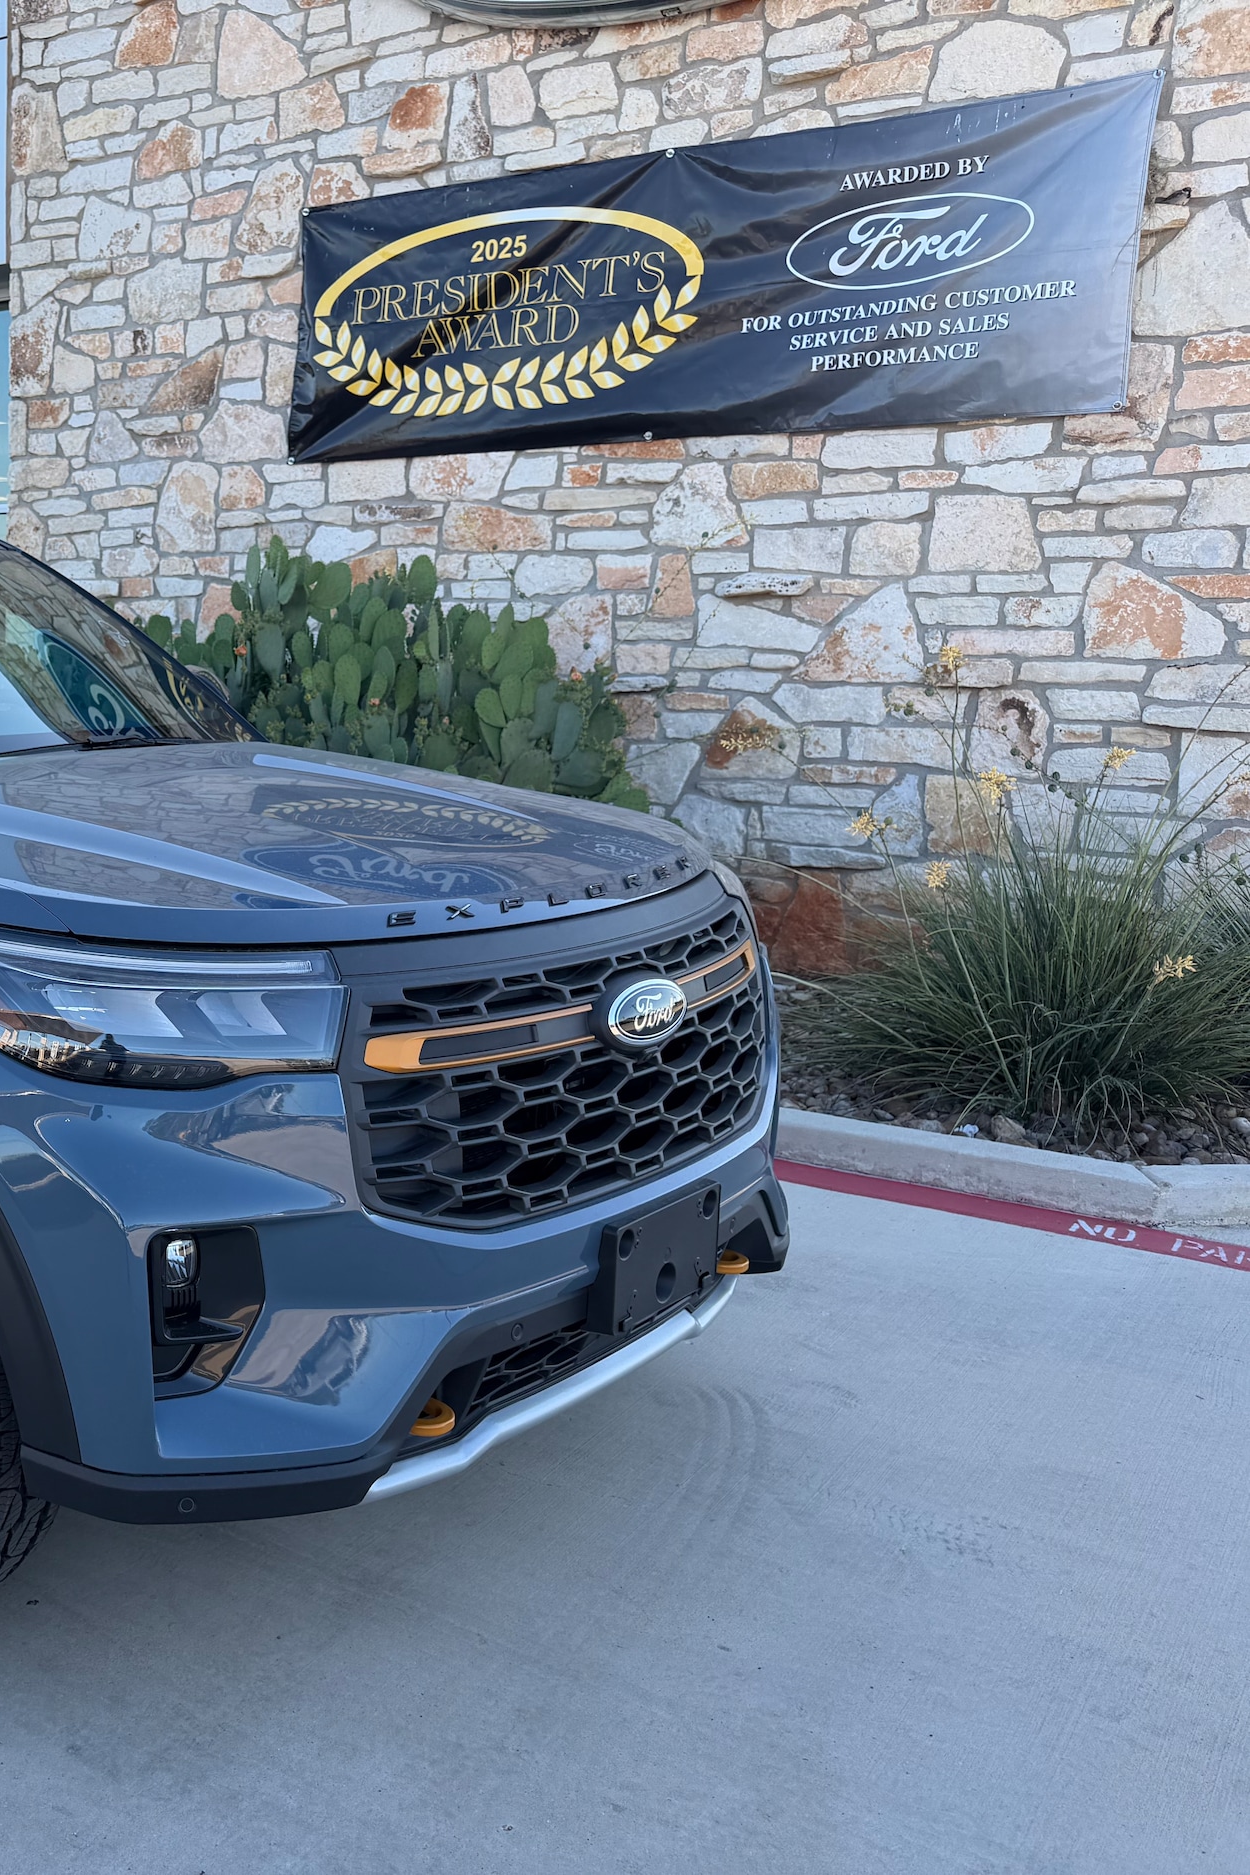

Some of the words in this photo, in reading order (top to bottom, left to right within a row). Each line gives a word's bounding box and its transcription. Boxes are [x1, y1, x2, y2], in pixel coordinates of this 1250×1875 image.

[840, 161, 950, 192] AWARDED
[957, 155, 990, 175] BY
[470, 235, 528, 262] 2025
[828, 206, 989, 277] Ford
[351, 251, 666, 325] PRESIDENT'S
[740, 315, 782, 333] FOR
[788, 294, 937, 328] OUTSTANDING
[944, 280, 1077, 309] CUSTOMER
[411, 304, 580, 358] AWARD
[789, 325, 878, 351] SERVICE
[885, 319, 932, 341] AND
[938, 312, 1011, 337] SALES
[810, 341, 980, 372] PERFORMANCE
[387, 856, 693, 928] EXPLORER
[633, 992, 680, 1033] Ford
[1068, 1219, 1137, 1242] NO
